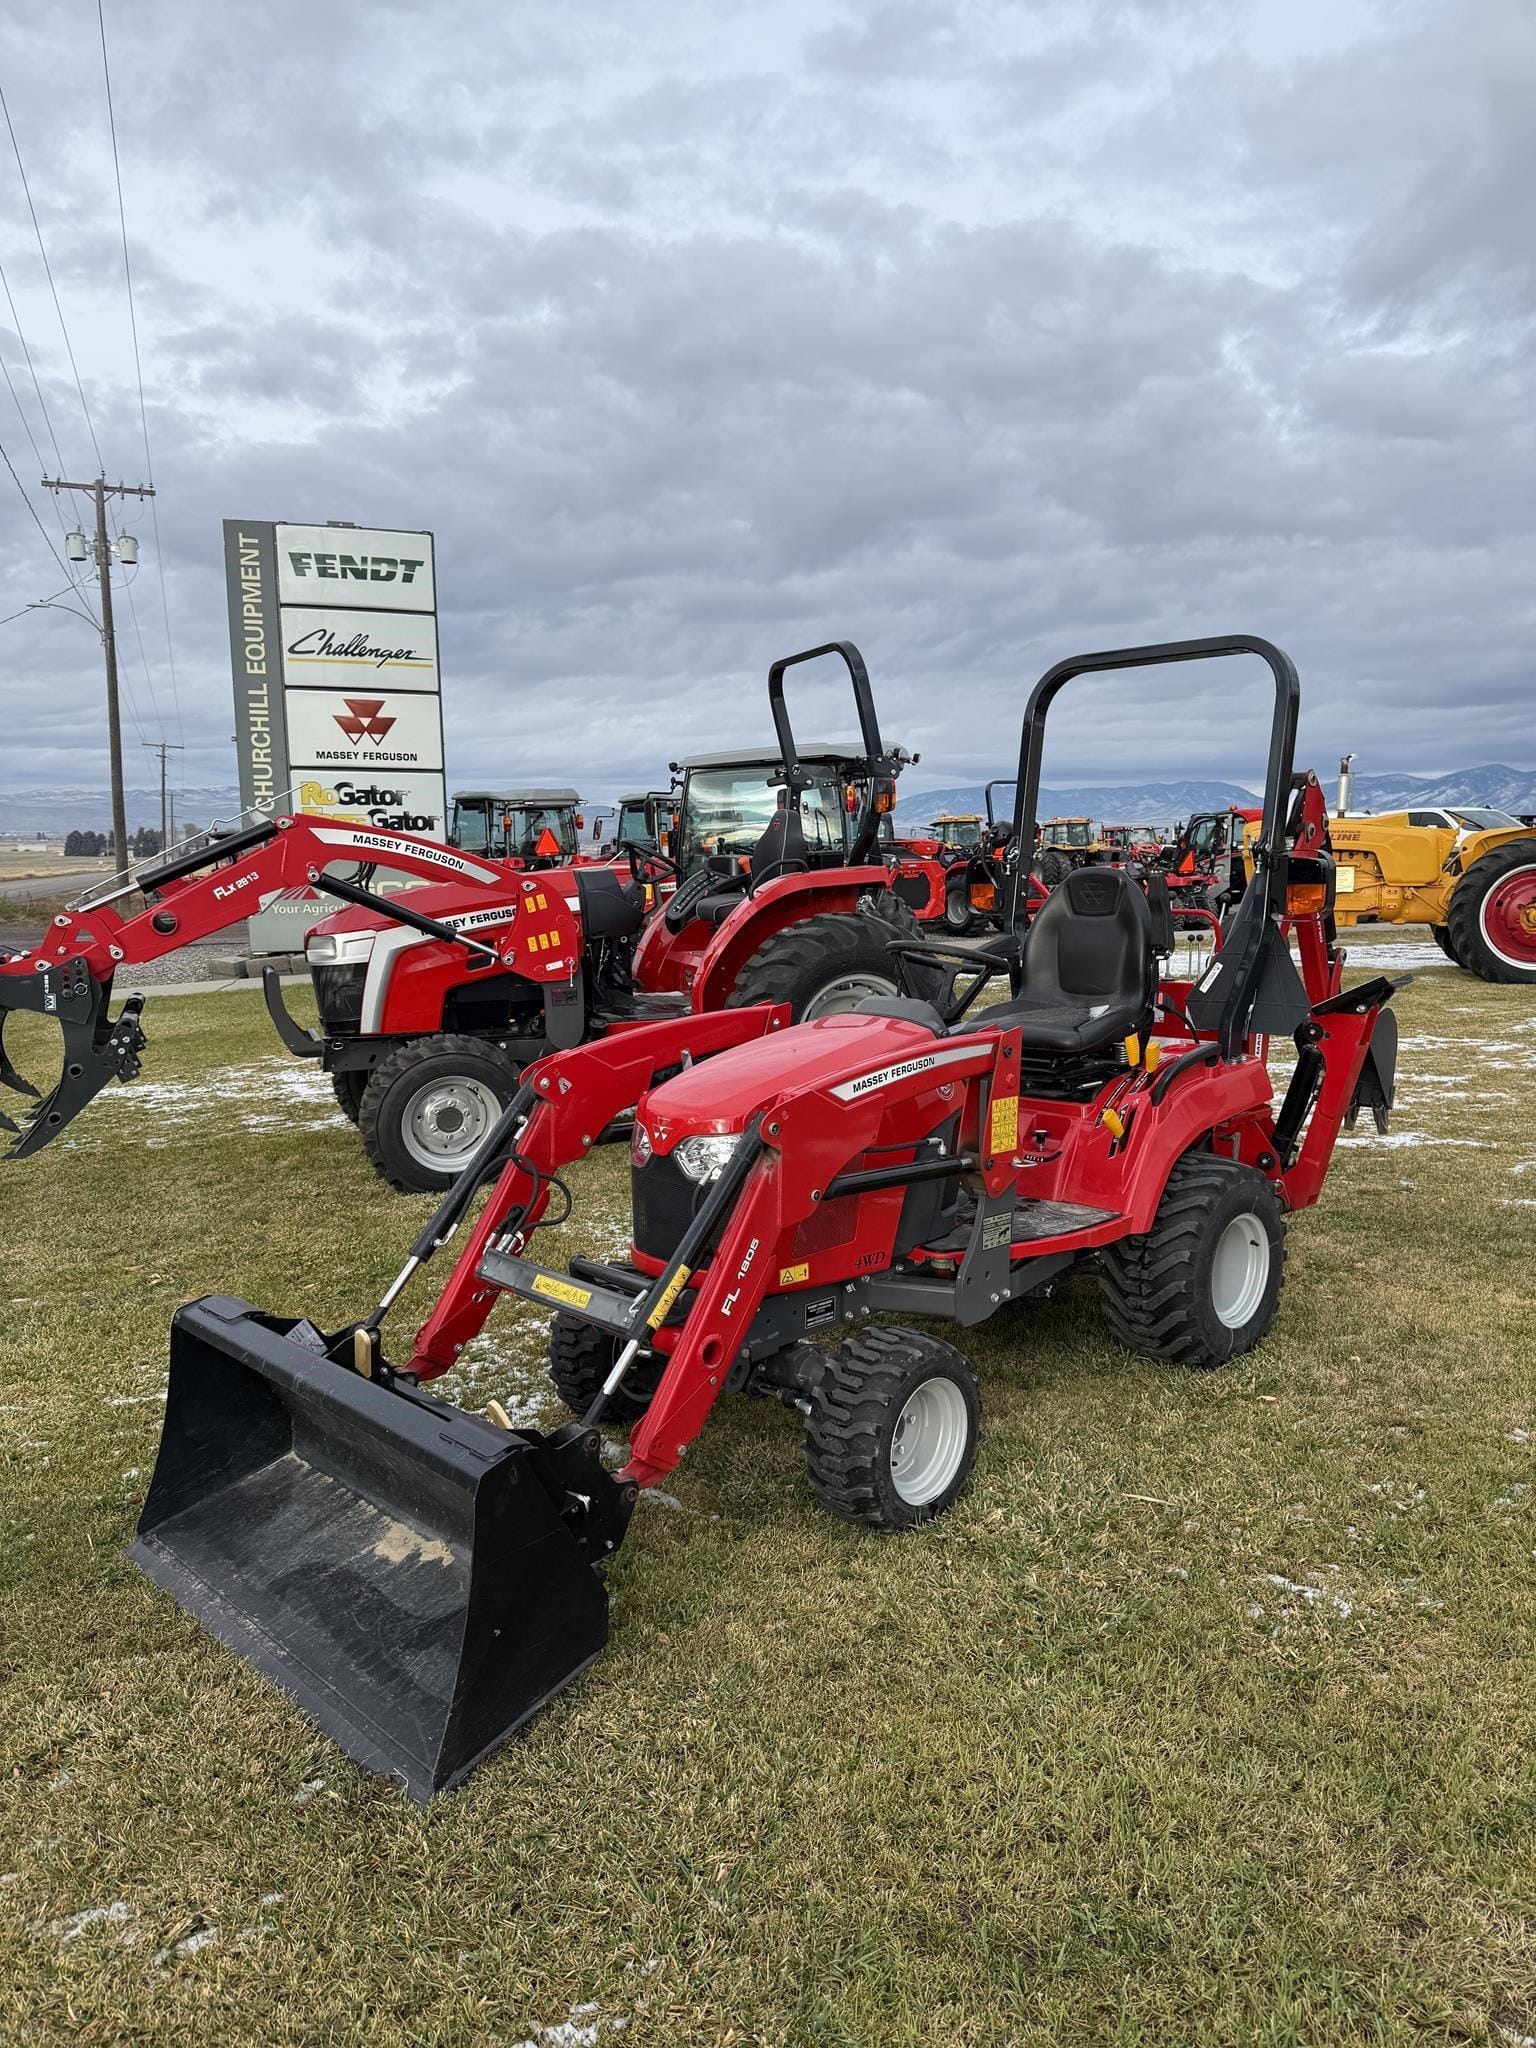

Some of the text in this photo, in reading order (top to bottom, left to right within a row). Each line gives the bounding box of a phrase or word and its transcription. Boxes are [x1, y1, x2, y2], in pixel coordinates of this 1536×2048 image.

[288, 552, 425, 584] FENDT
[288, 628, 434, 669] Challenger
[238, 532, 275, 813] CHURCHILL EQUIPMENT
[316, 751, 418, 762] MASSEY FERGUSON
[301, 781, 408, 806] RoGator
[352, 834, 465, 870] MASSEY FERGUSON
[235, 871, 259, 889] 2813
[272, 904, 300, 914] Your
[852, 1056, 935, 1093] MASSEY FERGUSON
[854, 1251, 886, 1269] 4WD
[720, 1237, 760, 1316] FL 1805
